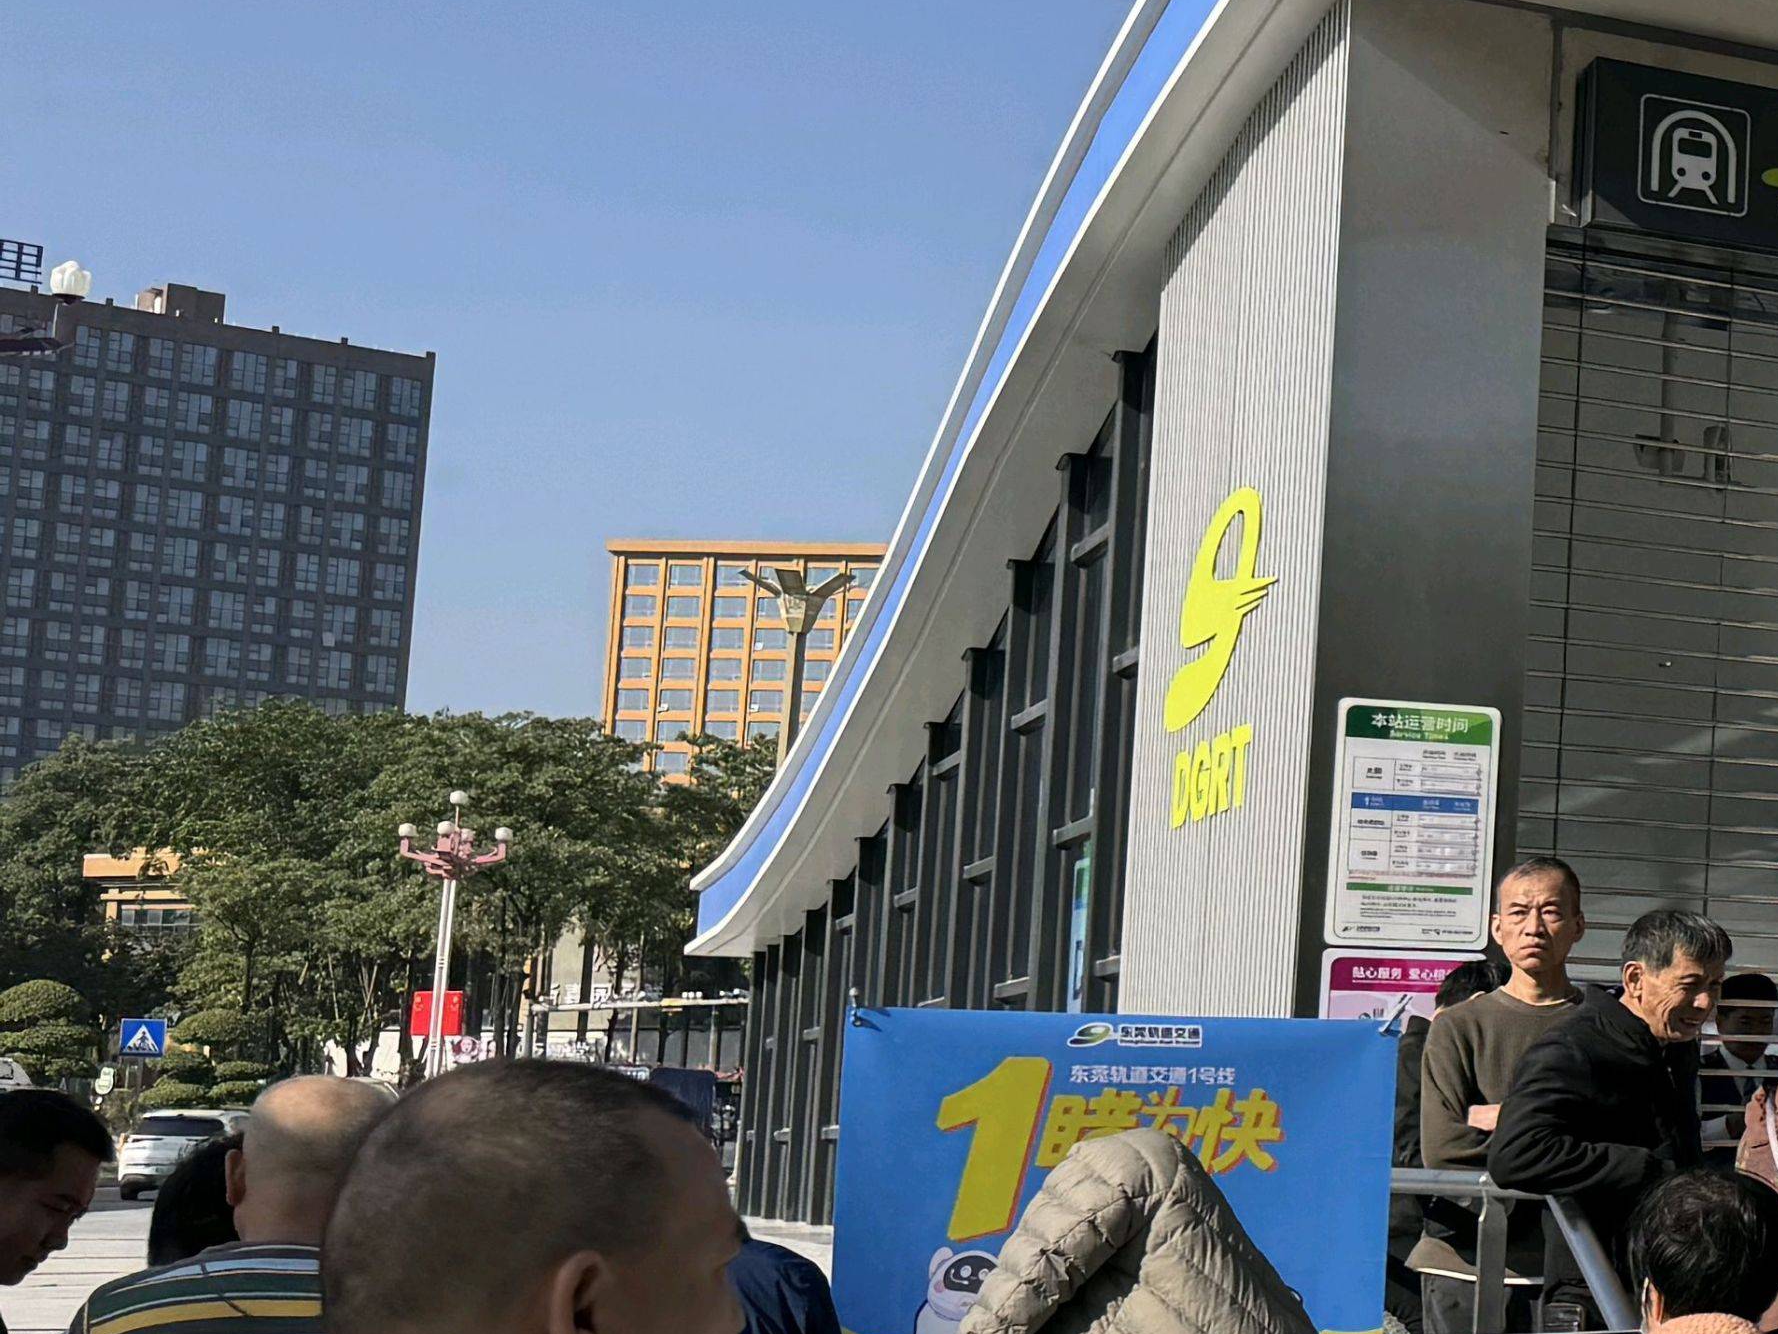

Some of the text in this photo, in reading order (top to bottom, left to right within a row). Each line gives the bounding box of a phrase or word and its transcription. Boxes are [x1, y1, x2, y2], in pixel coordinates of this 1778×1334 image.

[1371, 712, 1470, 734] 本站运营时间
[1170, 725, 1252, 830] DGRT
[1068, 1064, 1237, 1086] 东莞轨道交通1号线
